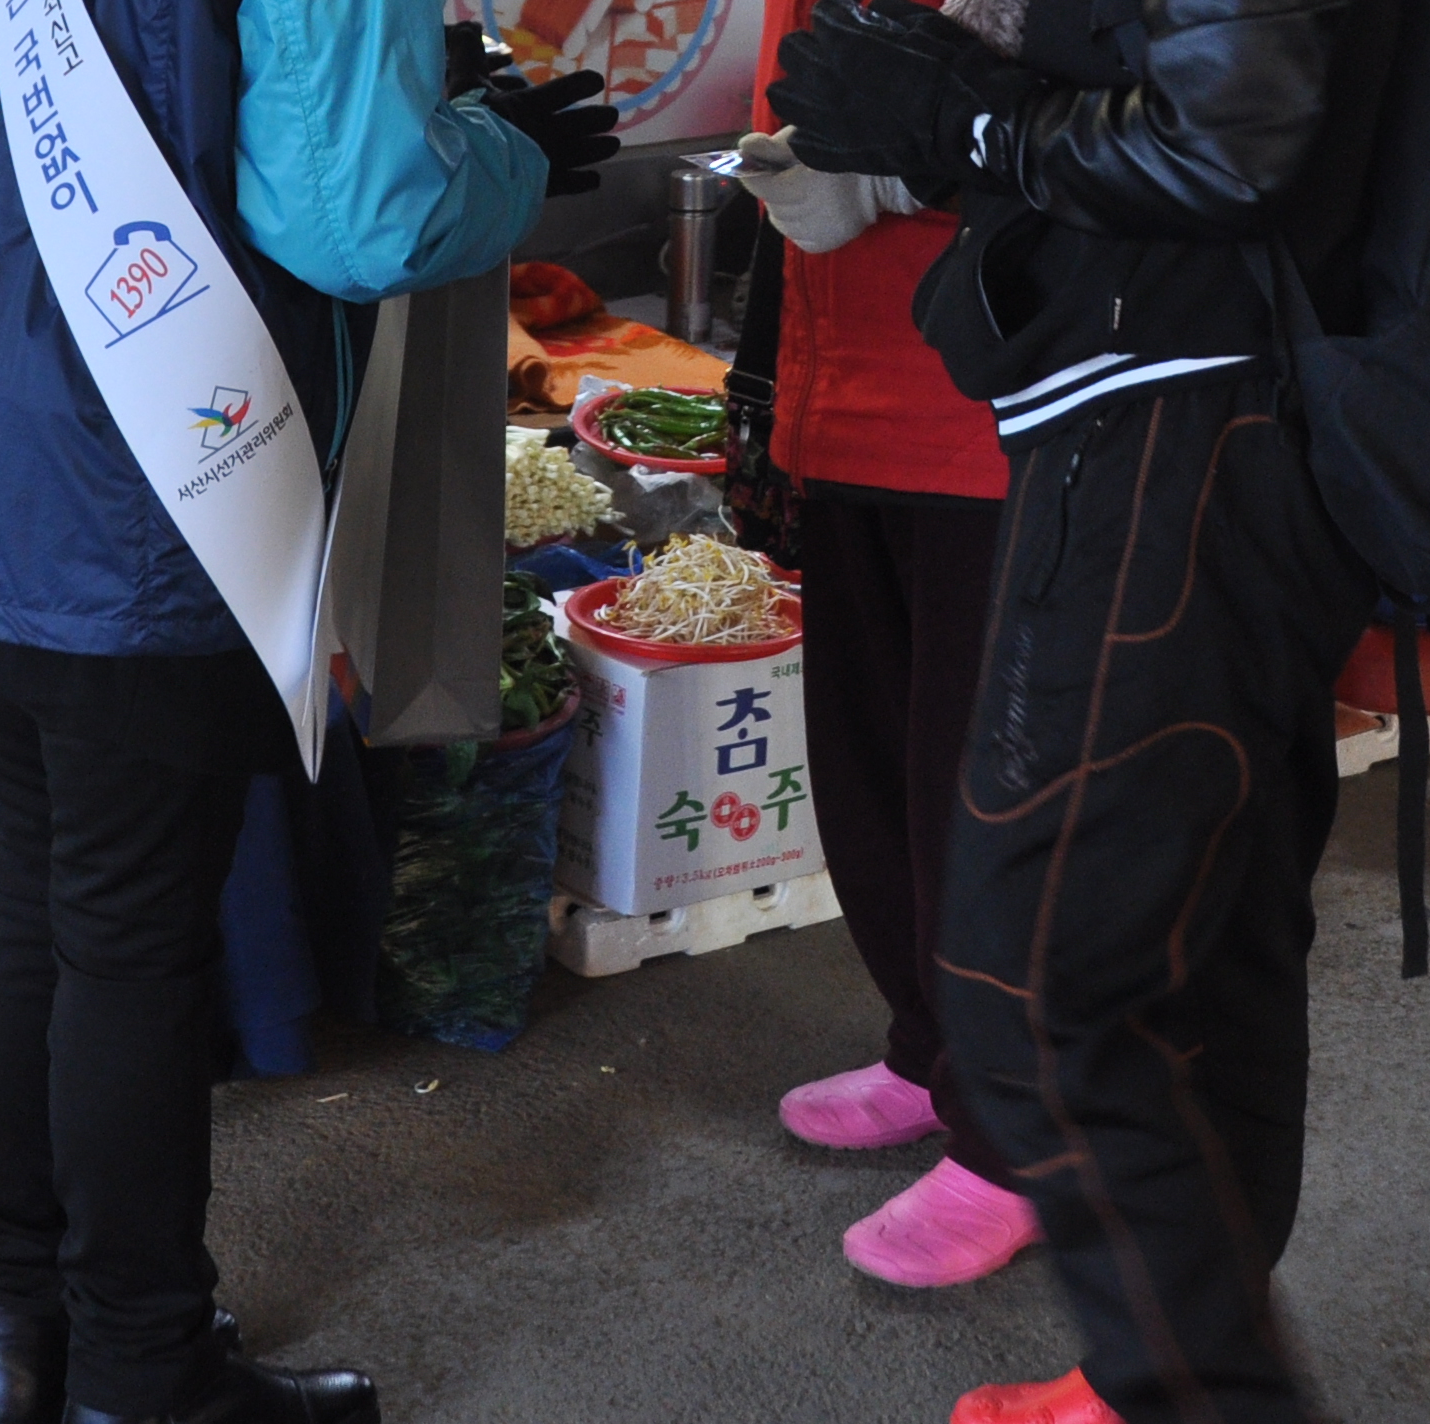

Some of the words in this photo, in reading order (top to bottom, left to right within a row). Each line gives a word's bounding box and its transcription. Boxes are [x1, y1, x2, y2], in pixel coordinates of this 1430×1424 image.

[13, 27, 100, 215] 국번없이
[109, 246, 170, 319] 1390
[176, 402, 295, 502] 서산시선거관리위원회
[715, 687, 773, 777] 참
